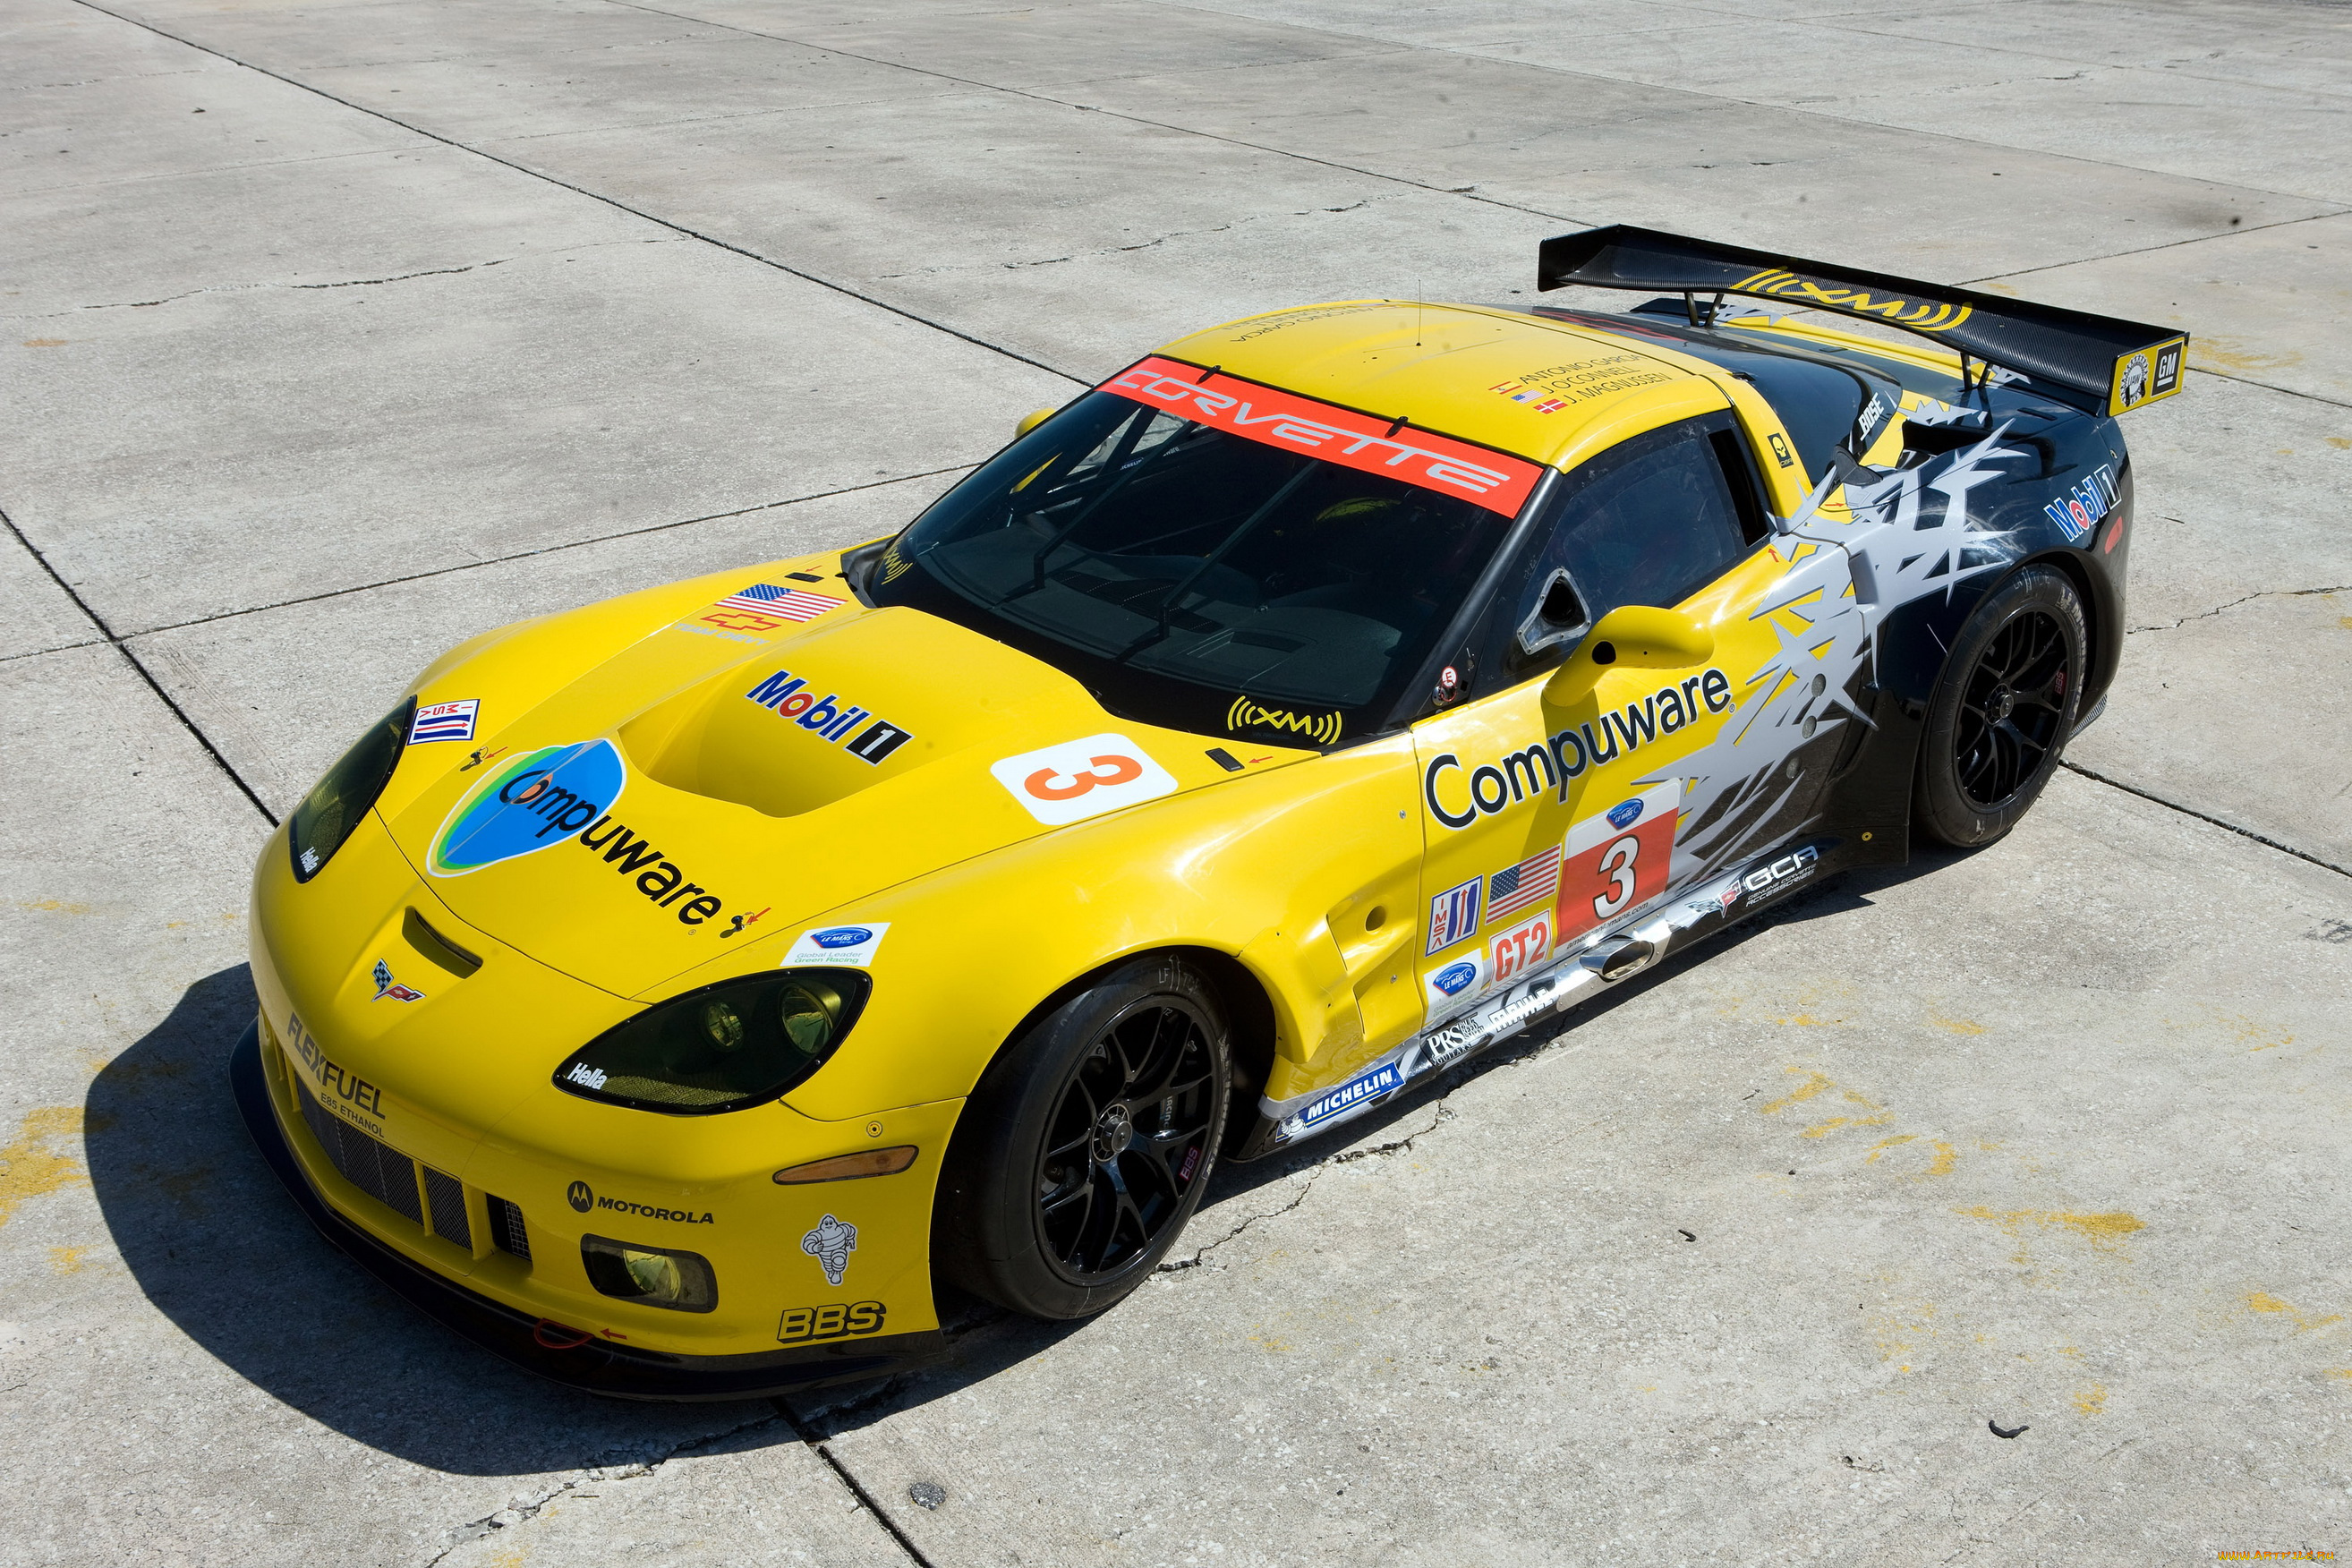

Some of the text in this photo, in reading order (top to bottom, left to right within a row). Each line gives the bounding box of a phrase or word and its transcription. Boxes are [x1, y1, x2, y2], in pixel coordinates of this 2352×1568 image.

[1230, 321, 1296, 342] GARCIA
[1519, 354, 1644, 385] ANTONIO GARCIA
[1552, 365, 1640, 389] O'CONNELL
[2127, 372, 2143, 387] UAW
[2158, 352, 2177, 379] GM
[1563, 371, 1673, 404] J. MAGNUSSEN
[1112, 369, 1511, 494] CORVETTE
[1858, 391, 1885, 442] BOSE
[2043, 474, 2109, 543] Mobil
[673, 623, 771, 645] TEAM CHEVY
[2054, 672, 2065, 695] BBS
[418, 703, 473, 719] IMSA
[745, 669, 873, 743] Mobil
[1425, 668, 1732, 830] Compuware
[1023, 754, 1144, 802] 3
[300, 846, 320, 873] Hella
[499, 769, 722, 925] Compuware
[1592, 834, 1640, 921] 3
[1743, 846, 1819, 891] GCA
[1745, 869, 1815, 908] ACCESSORIES
[1431, 898, 1448, 950] IMSA
[1495, 921, 1547, 983] GT2
[1444, 974, 1465, 990] LE MANS
[1427, 1023, 1466, 1058] PRS
[286, 1011, 386, 1121] FLEXFUEL
[567, 1062, 608, 1090] Hella
[1308, 1069, 1393, 1121] MICHELIN
[320, 1092, 385, 1138] E85 ETHANOL
[1180, 1146, 1199, 1181] BBS
[597, 1196, 715, 1224] MOTOROLA
[776, 1300, 887, 1344] BBS
